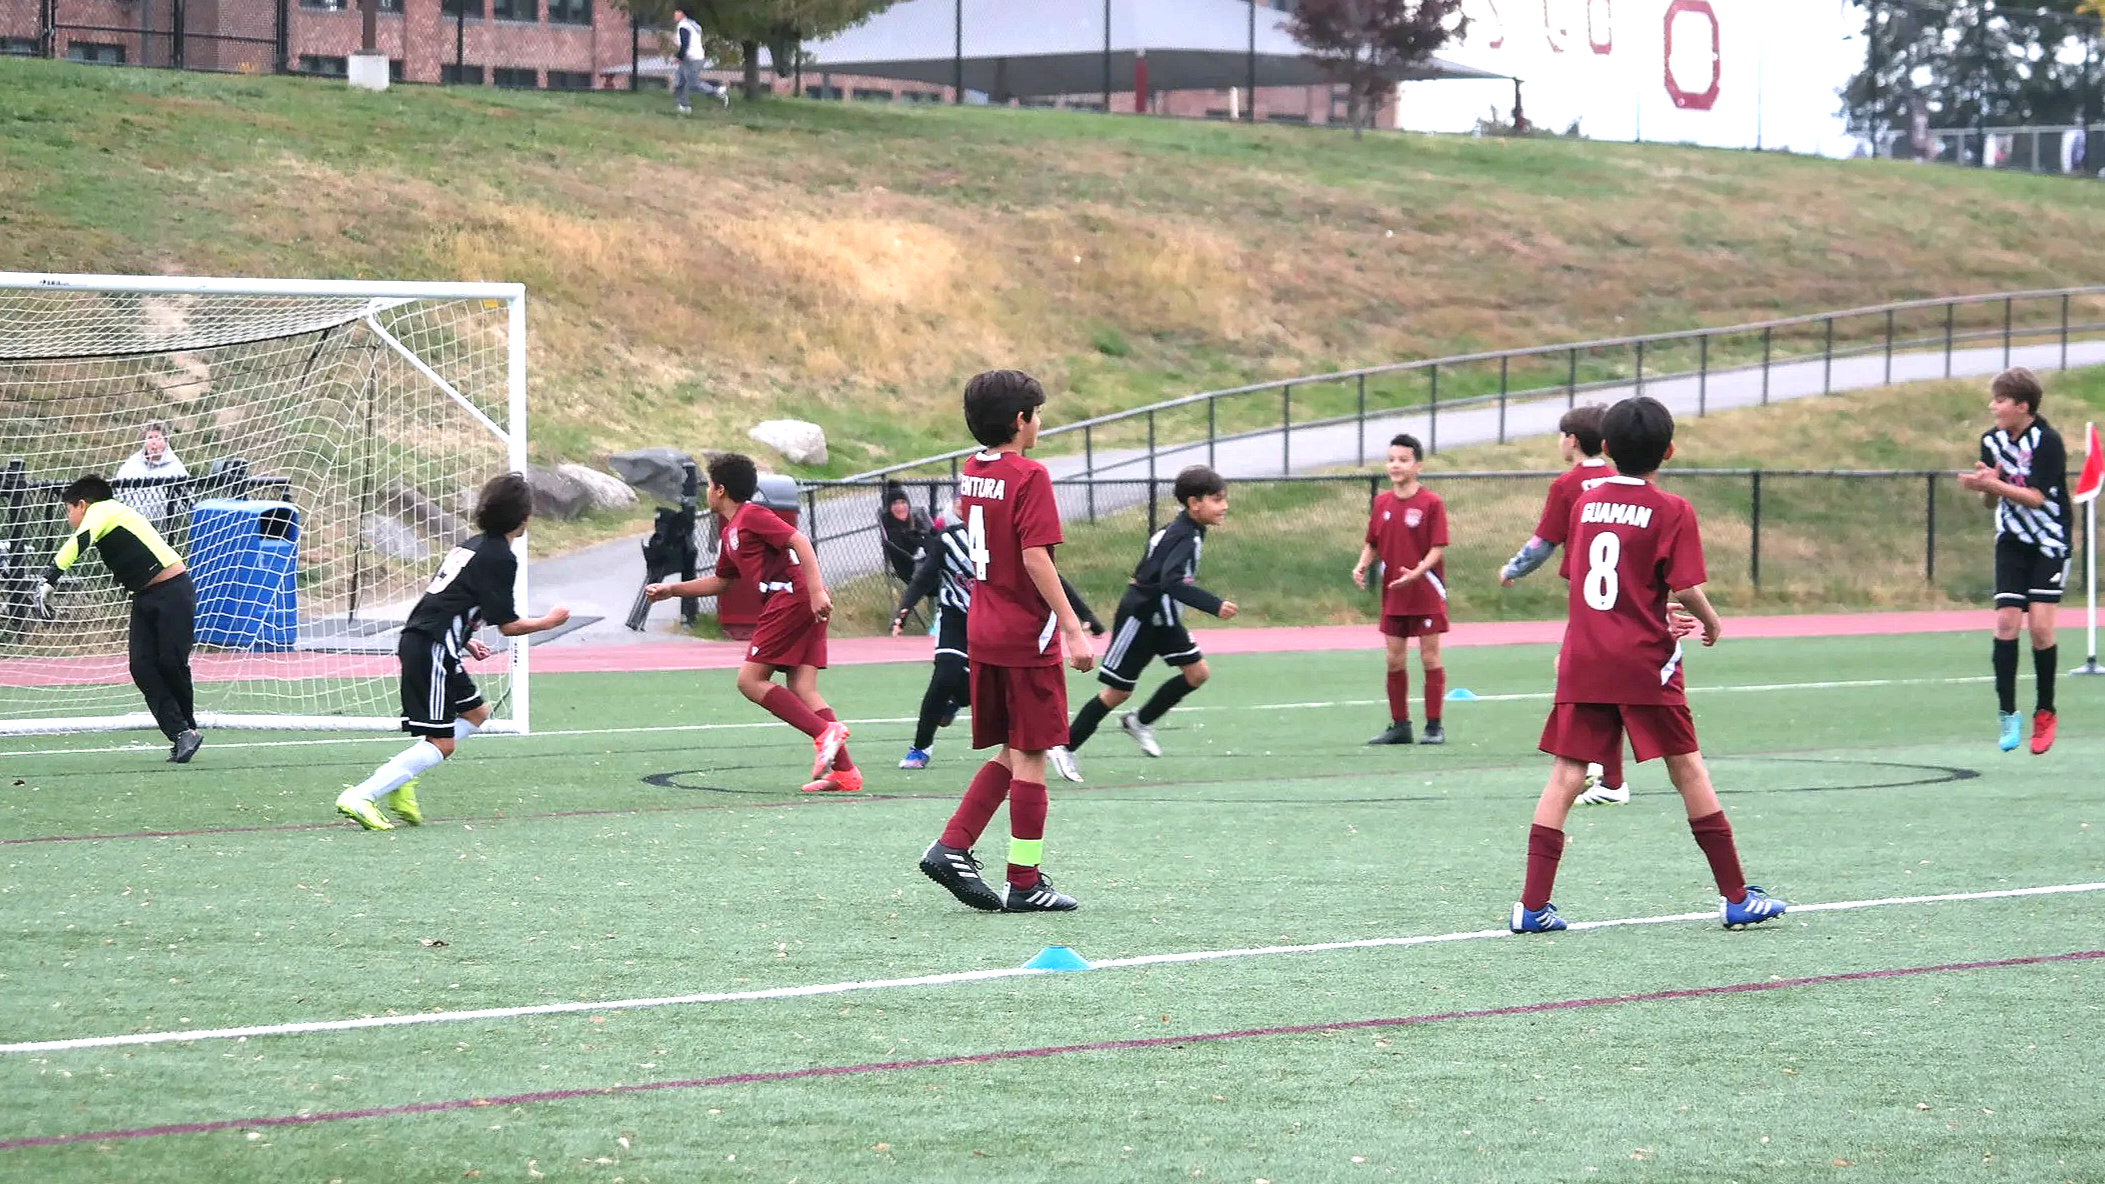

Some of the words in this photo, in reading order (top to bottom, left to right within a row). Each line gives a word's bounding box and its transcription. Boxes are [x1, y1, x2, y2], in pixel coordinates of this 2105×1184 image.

[969, 505, 990, 581] 4
[1581, 502, 1653, 528] GUAMAN
[1583, 531, 1620, 611] 8
